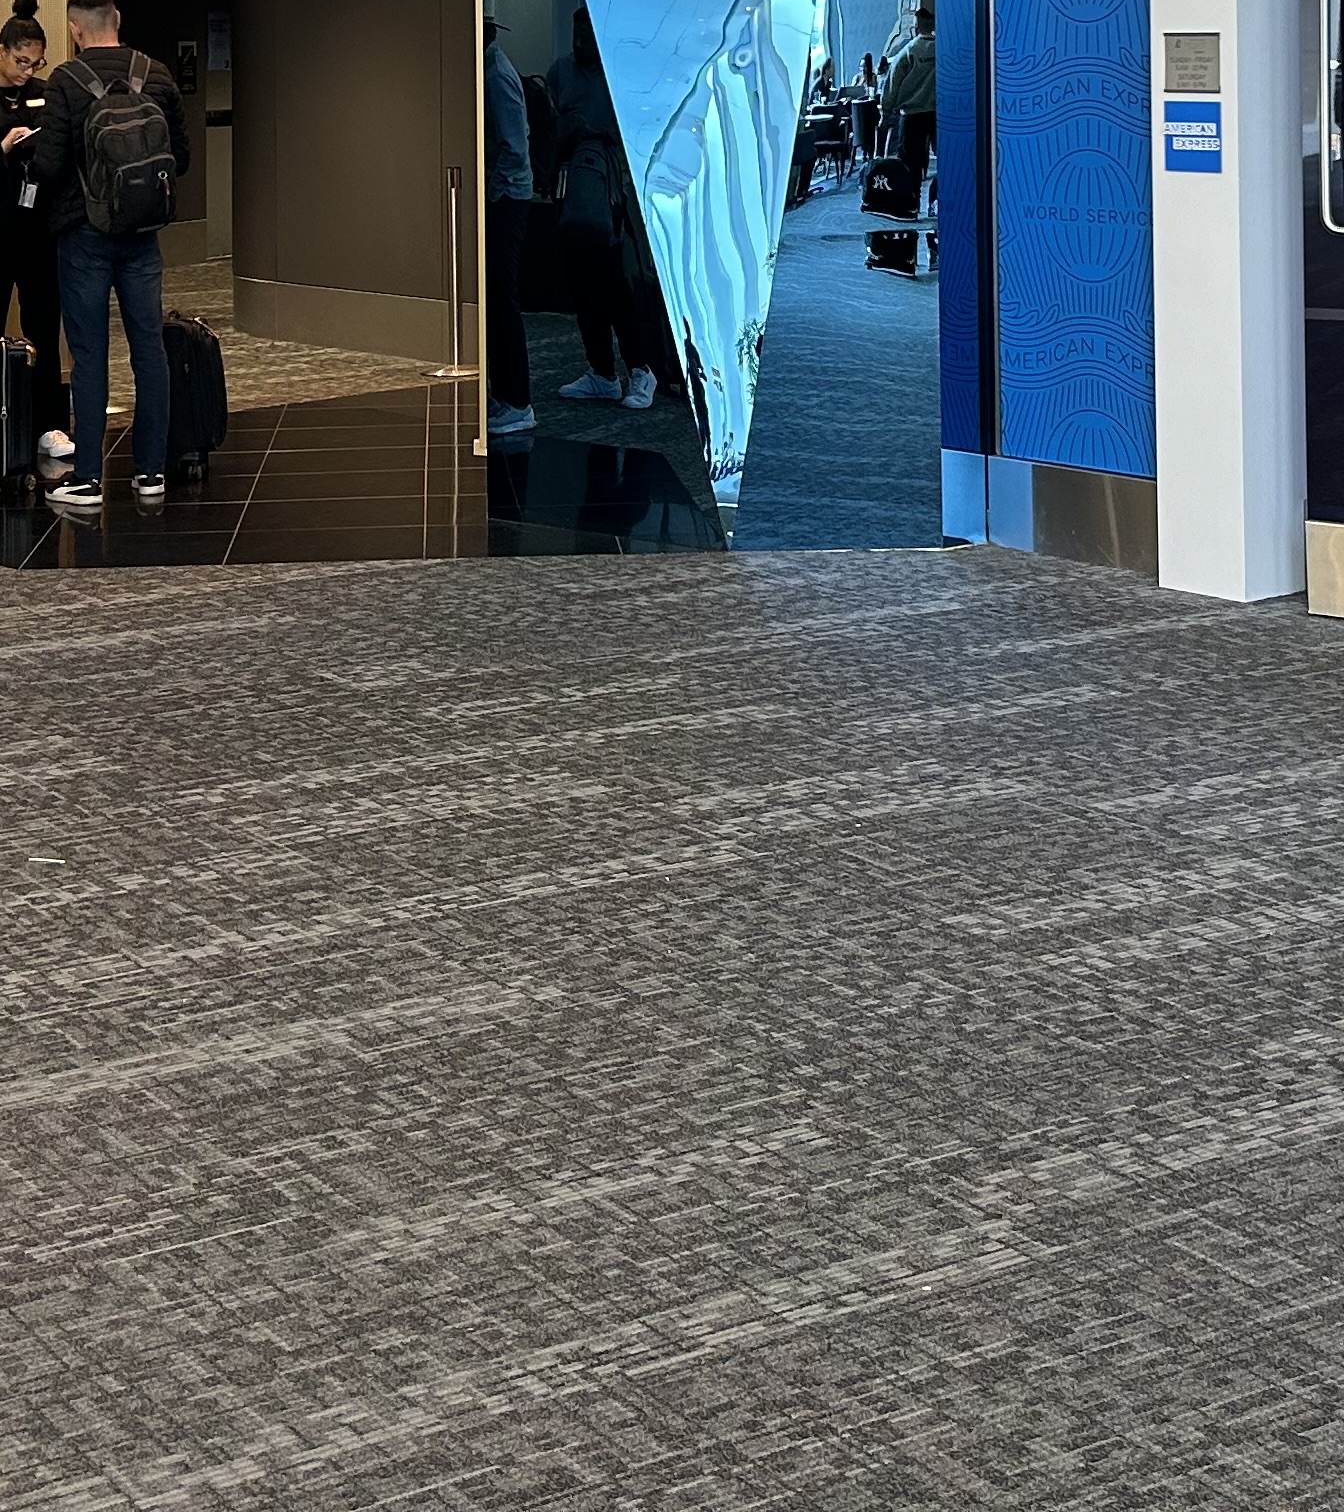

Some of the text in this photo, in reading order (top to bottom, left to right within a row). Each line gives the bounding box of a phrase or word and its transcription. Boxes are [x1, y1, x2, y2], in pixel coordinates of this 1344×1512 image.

[1164, 122, 1215, 135] AMERICAN
[1174, 138, 1220, 151] EXPRESS
[1022, 205, 1152, 227] WORLD SERVIC
